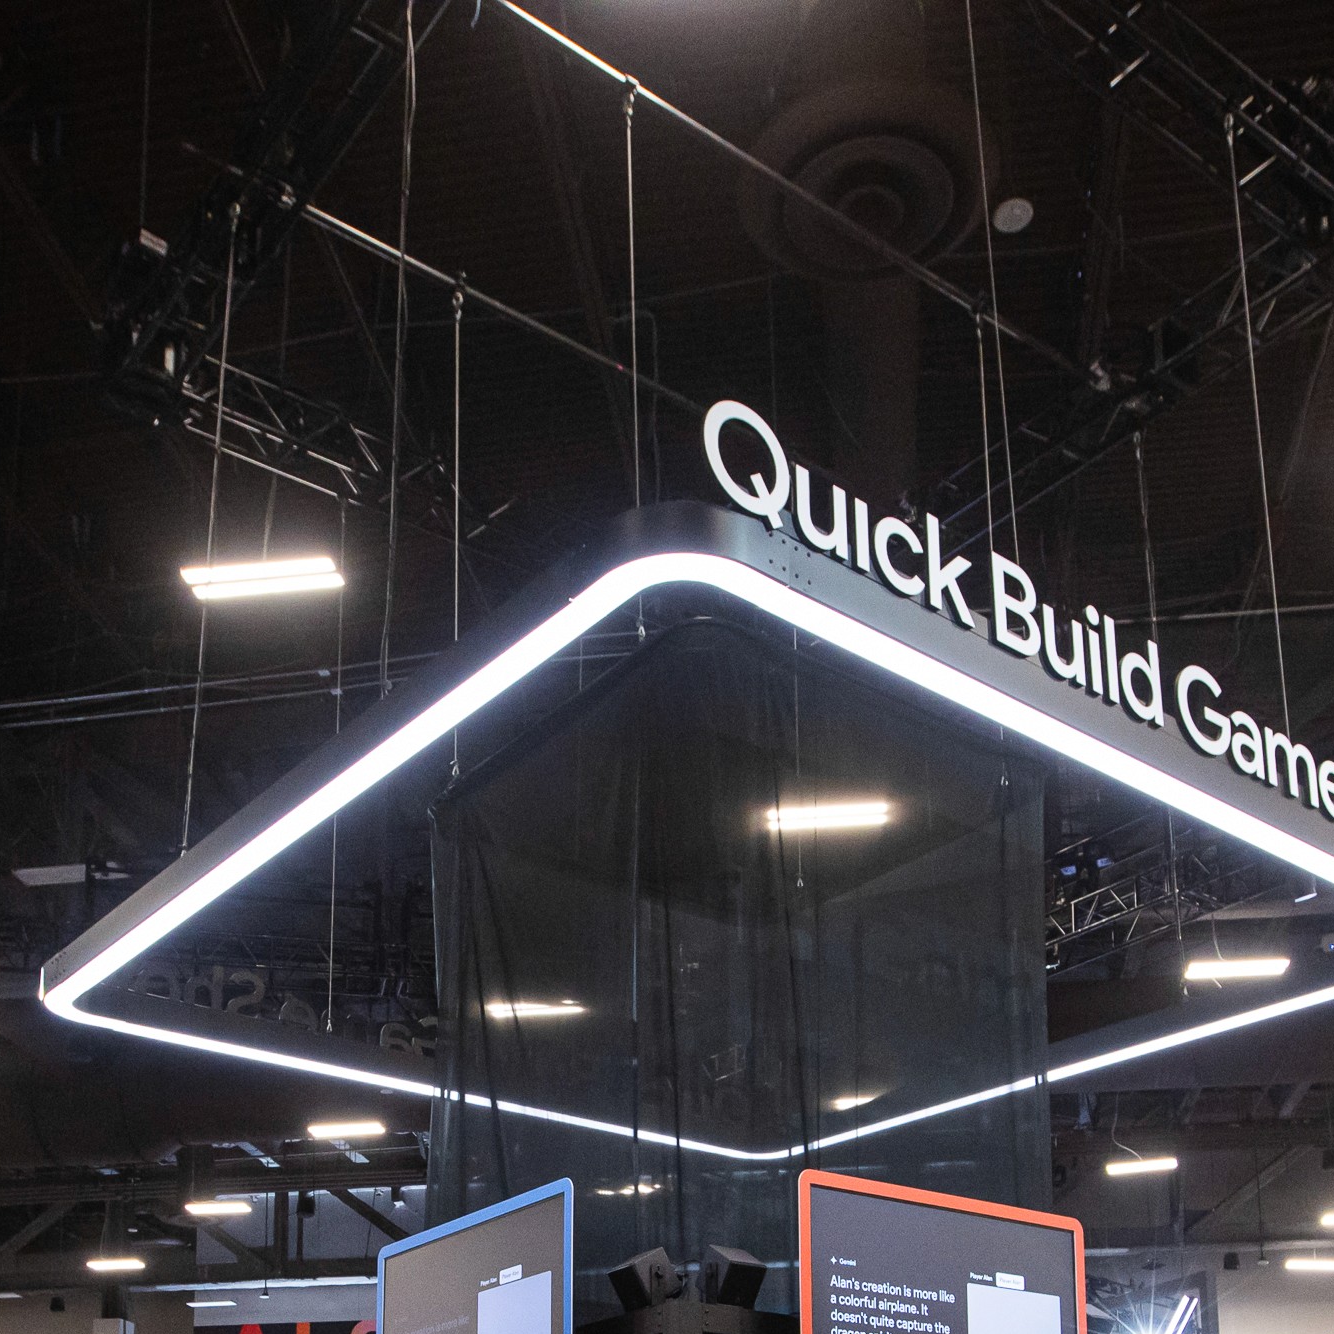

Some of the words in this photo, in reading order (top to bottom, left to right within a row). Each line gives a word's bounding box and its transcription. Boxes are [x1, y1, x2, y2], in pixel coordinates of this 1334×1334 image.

[703, 400, 975, 628] Quick
[992, 550, 1165, 727] Build
[839, 1257, 857, 1267] Gemini
[830, 1275, 860, 1290] Alan's
[862, 1281, 902, 1297] creation
[903, 1285, 912, 1297] is
[913, 1288, 938, 1301] more
[939, 1290, 956, 1303] like
[830, 1294, 837, 1304] a
[838, 1294, 877, 1309] colorful
[878, 1300, 920, 1316] airplane.
[921, 1304, 929, 1316] It
[830, 1310, 868, 1325] doesn't
[869, 1314, 895, 1329] quite
[896, 1318, 933, 1333] capture
[934, 1322, 951, 1334] the
